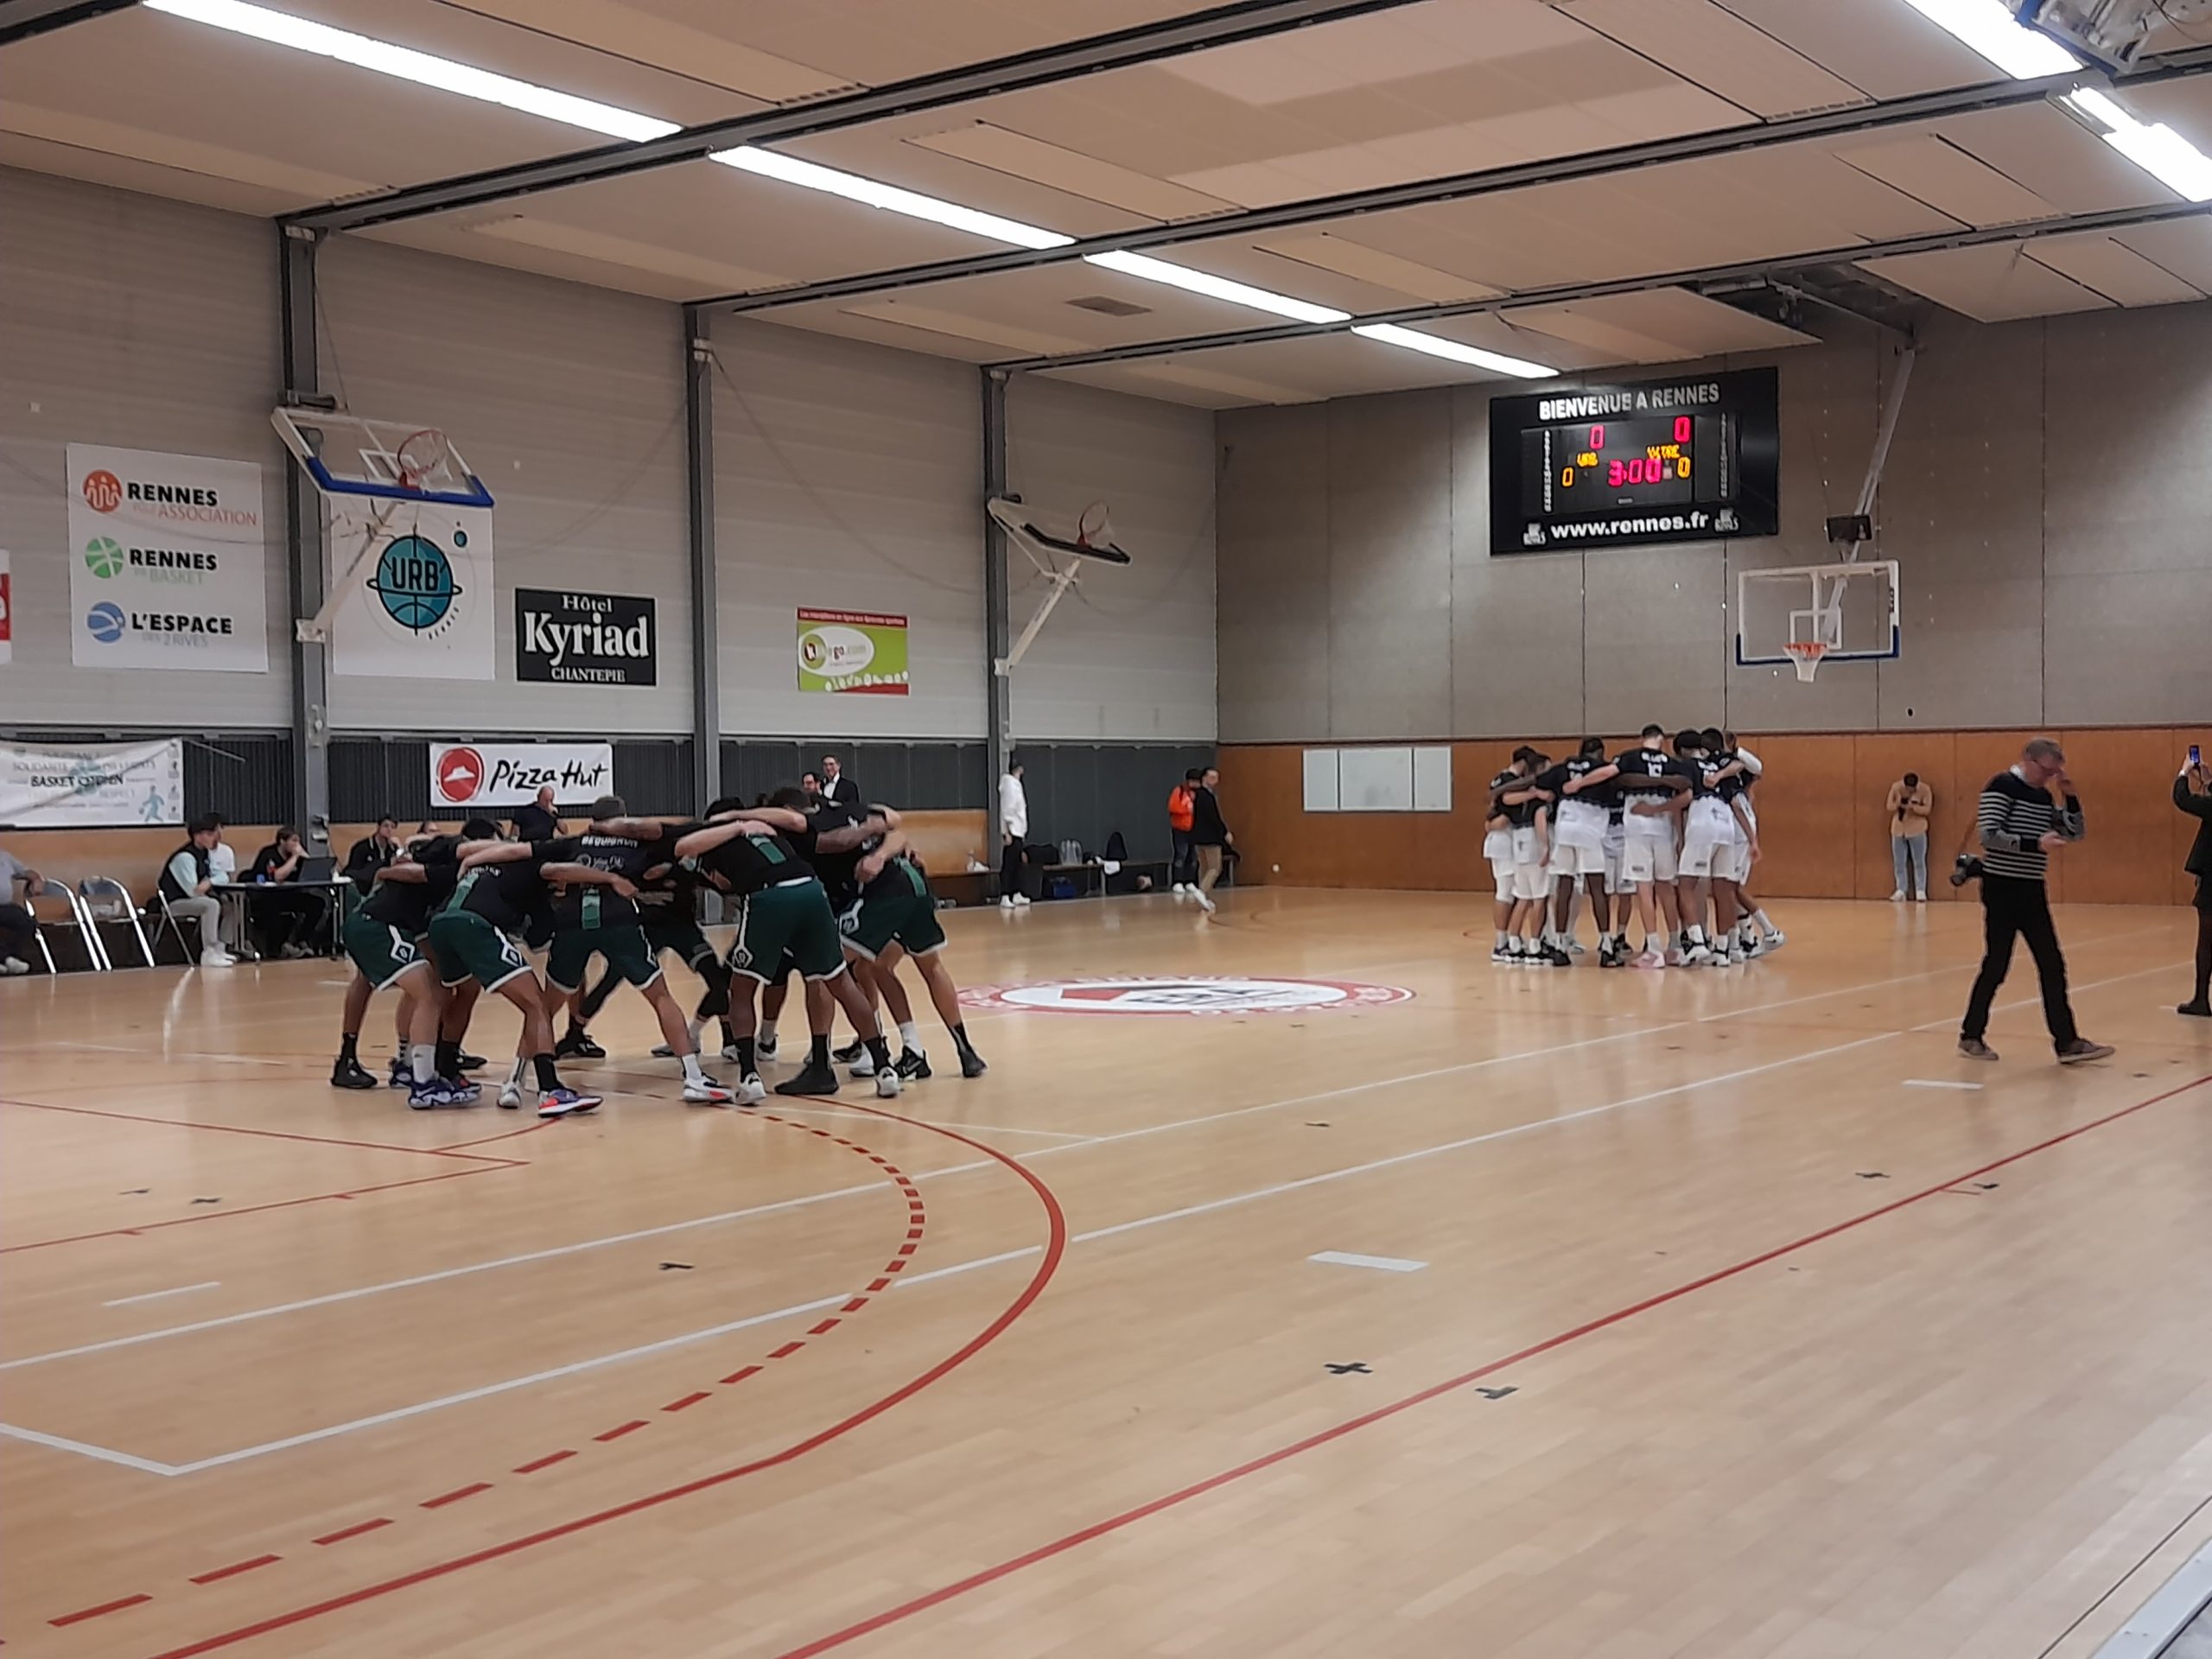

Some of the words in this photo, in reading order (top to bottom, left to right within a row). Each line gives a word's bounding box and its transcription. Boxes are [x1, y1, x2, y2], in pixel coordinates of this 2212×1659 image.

[1539, 391, 1631, 420] BIENVENUE
[1636, 391, 1649, 410] A
[1652, 384, 1719, 408] RENNES
[1590, 425, 1604, 449] 0
[1675, 416, 1690, 442] 0
[1562, 467, 1573, 486] 0
[1677, 457, 1690, 478] 0
[128, 482, 218, 506] RENNES
[158, 505, 257, 525] ASSOCIATION
[1551, 511, 1709, 538] www.rennes.fr
[130, 549, 217, 570] RENNES
[391, 558, 438, 592] URB
[563, 594, 612, 613] Hôtel
[131, 612, 232, 634] L'ESPACE
[524, 611, 649, 666] Kyriad
[551, 667, 626, 683] CHANTEPIE
[31, 776, 73, 787] BASKET
[489, 760, 557, 792] Pizza
[561, 760, 608, 788] Hut
